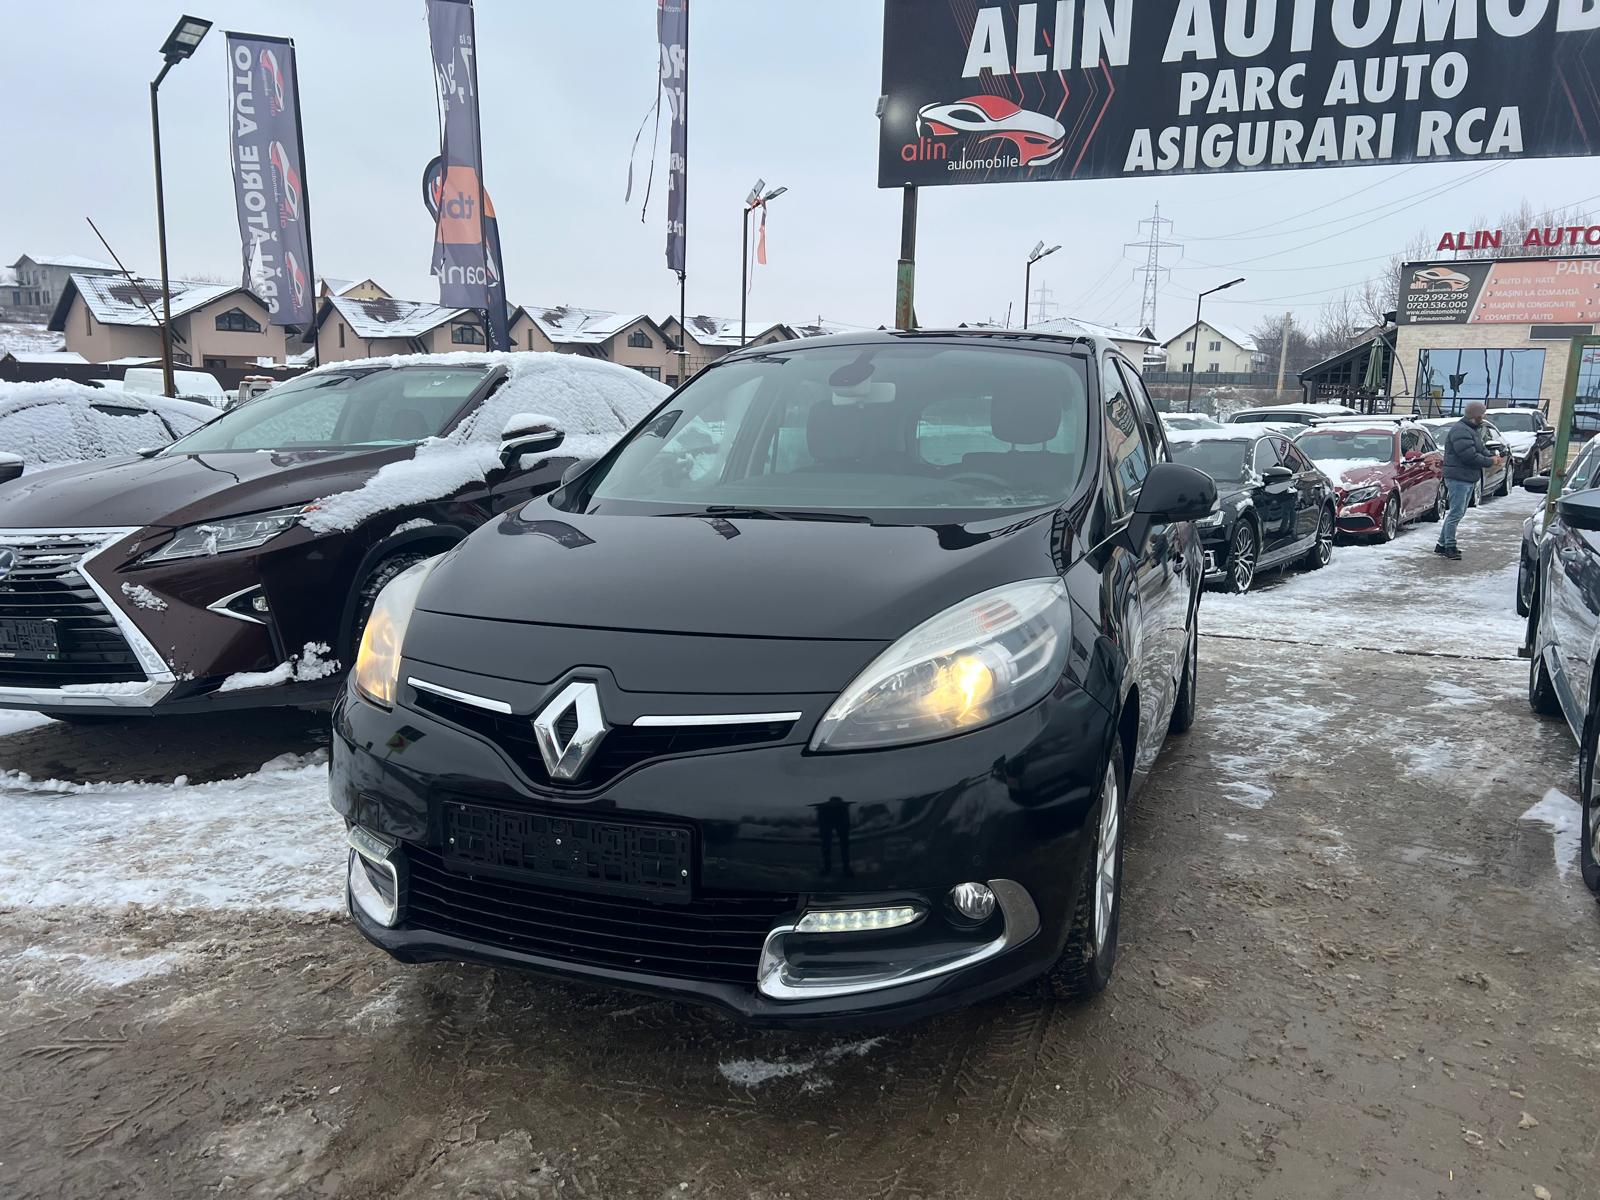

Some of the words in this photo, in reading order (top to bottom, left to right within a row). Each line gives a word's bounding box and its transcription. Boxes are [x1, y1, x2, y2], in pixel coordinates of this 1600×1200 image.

[961, 0, 1133, 78] ALIN
[1178, 63, 1306, 116] PARC
[1323, 52, 1469, 106] AUTO
[901, 136, 947, 162] alin
[1123, 113, 1397, 172] ASIGURARI
[1416, 106, 1524, 157] RCA
[1437, 230, 1502, 251] ALIN
[1523, 226, 1600, 247] AUTO
[1407, 301, 1467, 309] 0720.536.000
[1408, 293, 1468, 301] 0729.992.999
